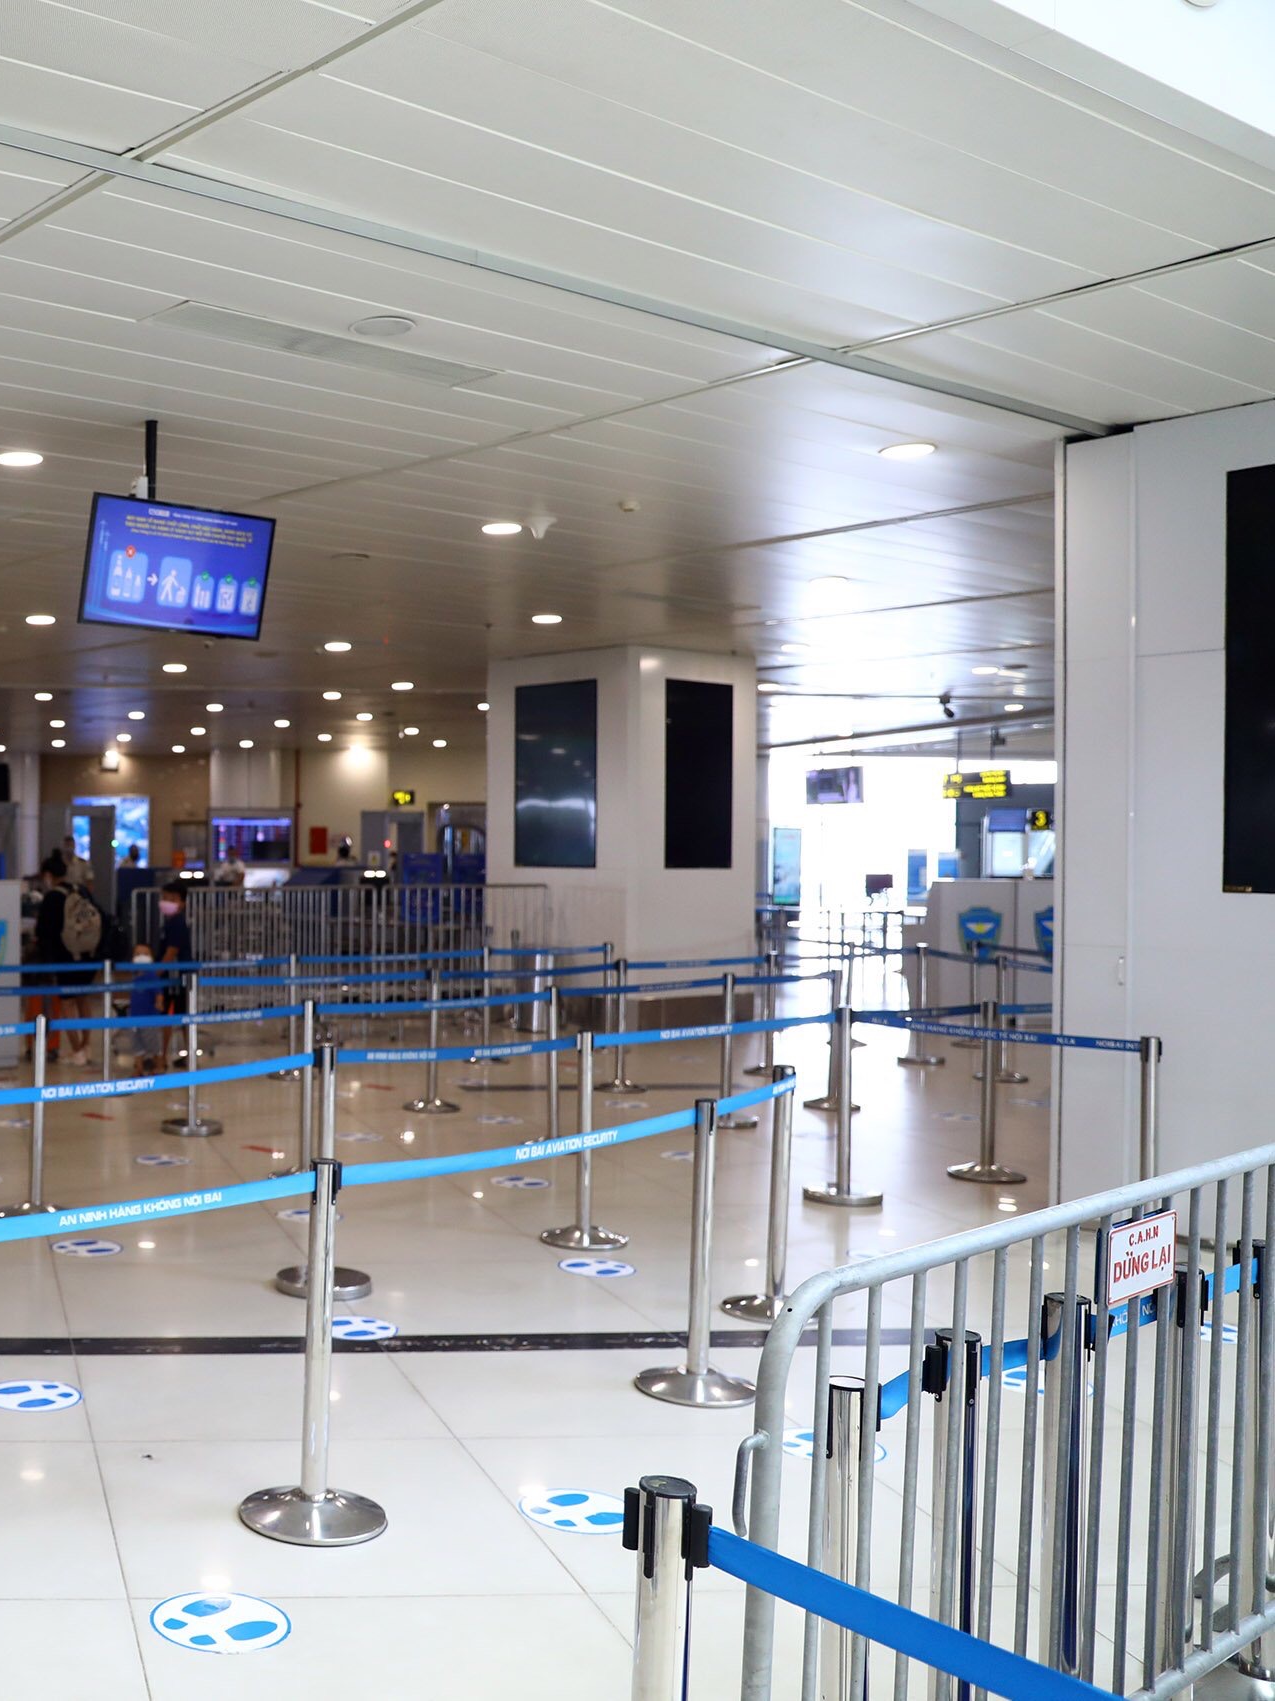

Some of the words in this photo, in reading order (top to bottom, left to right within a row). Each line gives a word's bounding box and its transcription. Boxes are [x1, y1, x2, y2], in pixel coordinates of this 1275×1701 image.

[1035, 810, 1047, 827] 3
[74, 1082, 115, 1096] AVIATION
[116, 1078, 155, 1092] SECURITY
[545, 1138, 583, 1155] AVIATION
[583, 1130, 618, 1146] SECURITY
[59, 1214, 77, 1227] AN
[79, 1210, 107, 1223] NINH
[1152, 1244, 1171, 1271] LẠI
